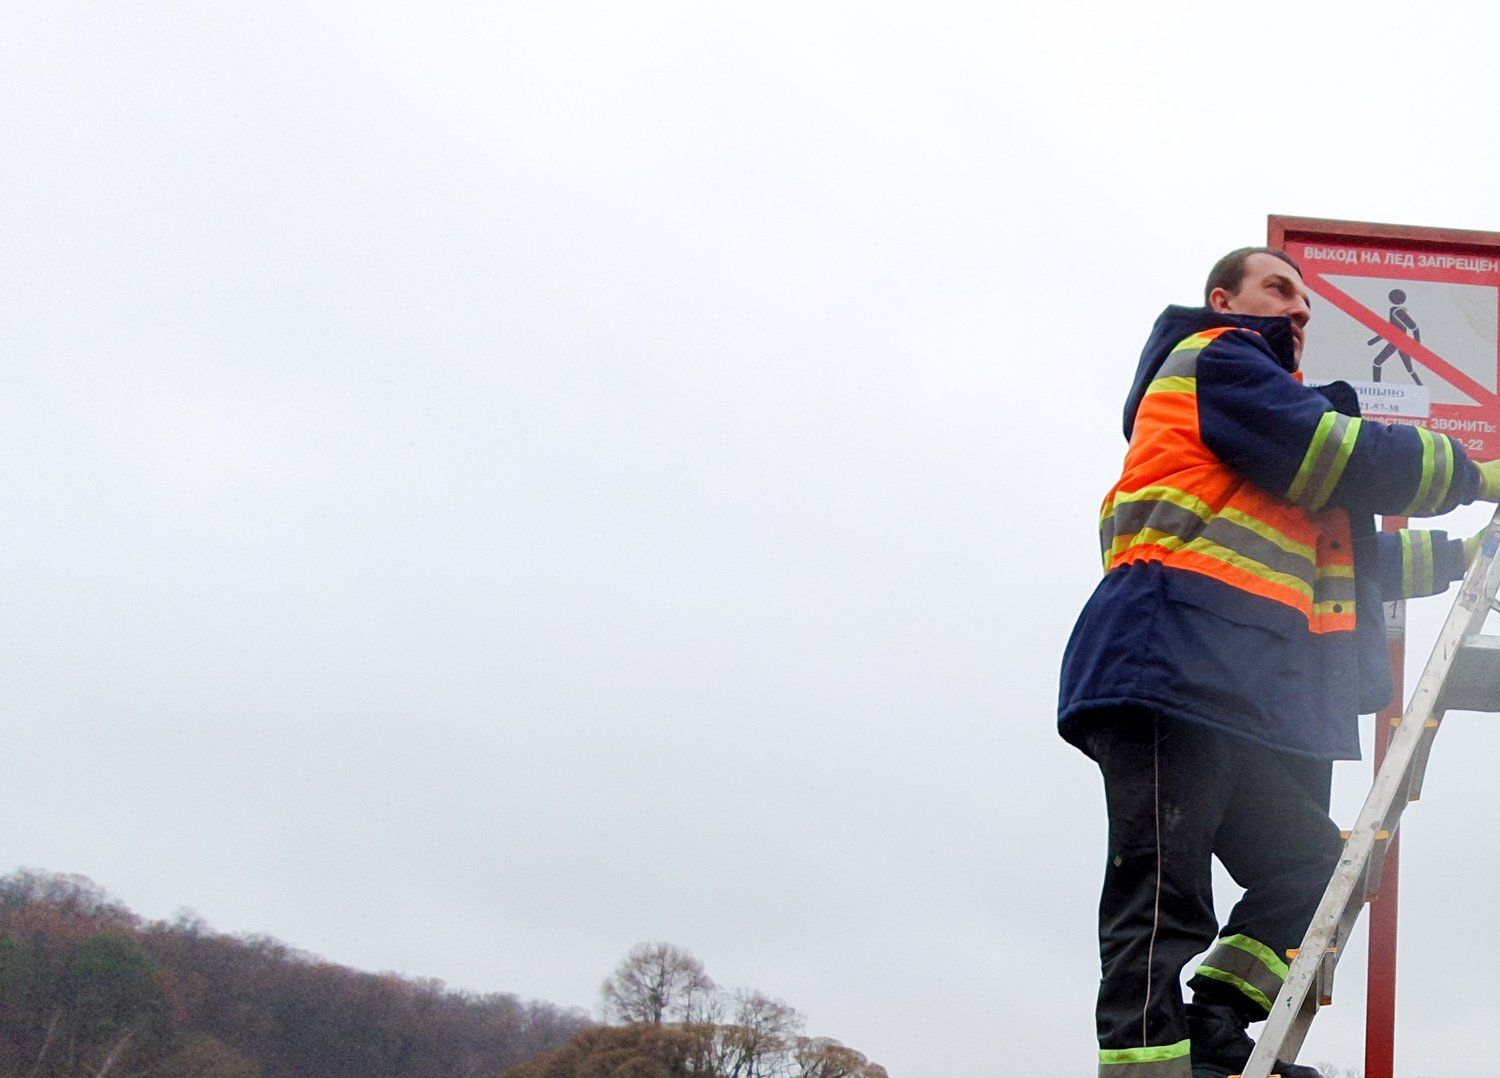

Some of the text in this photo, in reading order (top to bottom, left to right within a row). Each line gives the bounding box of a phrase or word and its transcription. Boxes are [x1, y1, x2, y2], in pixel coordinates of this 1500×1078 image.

[1303, 246, 1498, 274] ВЫХОД НА ЛЕД ЗАПРЕЩЕН
[1430, 417, 1497, 433] ЗВОНИТЬ:
